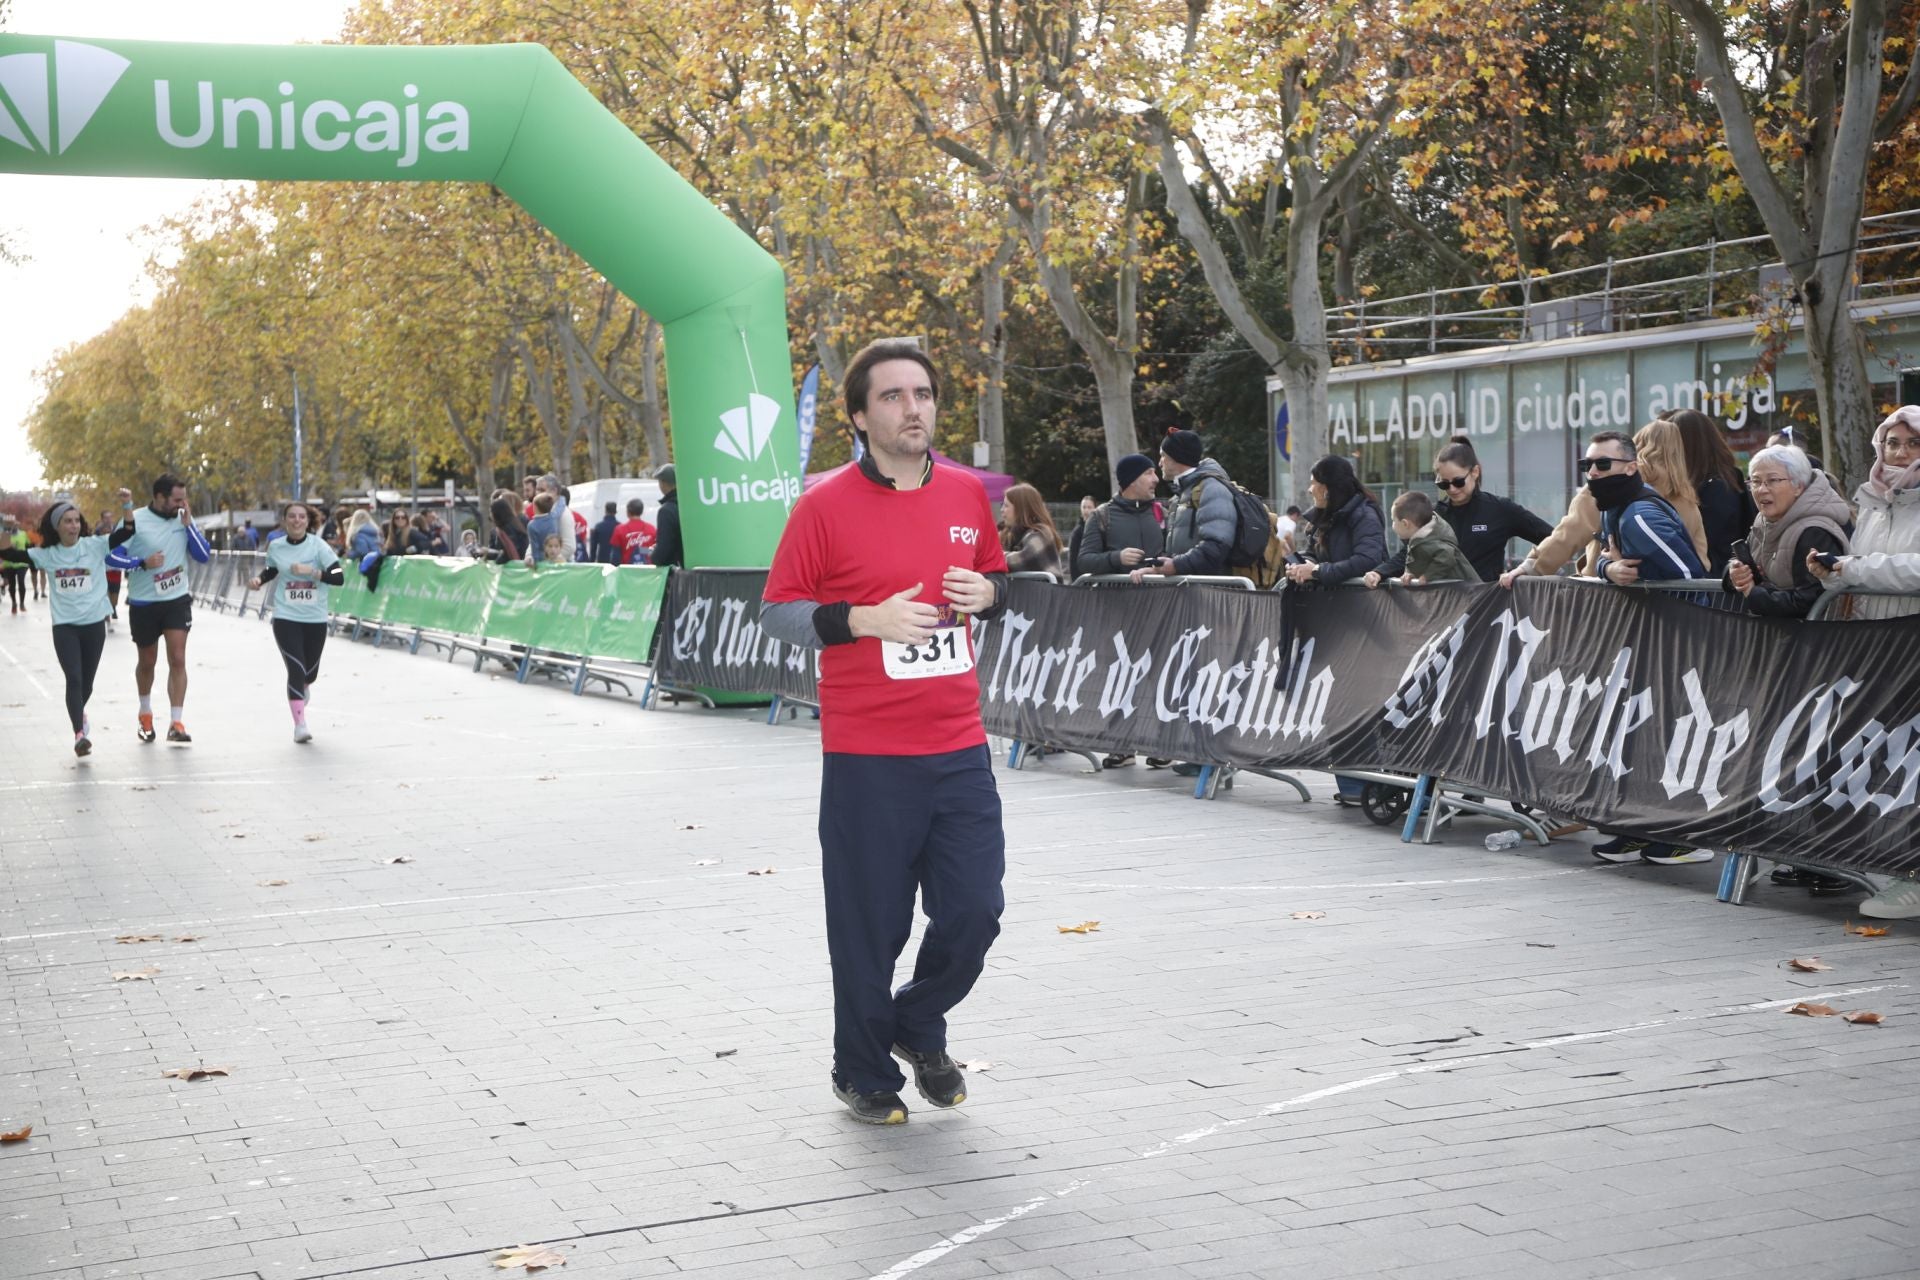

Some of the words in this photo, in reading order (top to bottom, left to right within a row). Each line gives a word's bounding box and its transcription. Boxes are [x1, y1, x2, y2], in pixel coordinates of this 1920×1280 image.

[154, 79, 470, 168] Unicaja
[1327, 387, 1500, 444] ALLADOLID
[1516, 373, 1631, 432] ciudad
[1648, 363, 1777, 430] amiga
[698, 471, 799, 507] Unicaja
[60, 577, 85, 589] 847
[160, 576, 181, 591] 845
[290, 590, 312, 600] 846
[898, 631, 956, 664] 331
[988, 609, 1096, 715] Norte
[1098, 630, 1152, 719] de
[1155, 624, 1336, 742] Castilla
[1475, 608, 1653, 781] Norte
[1660, 667, 1750, 812] de
